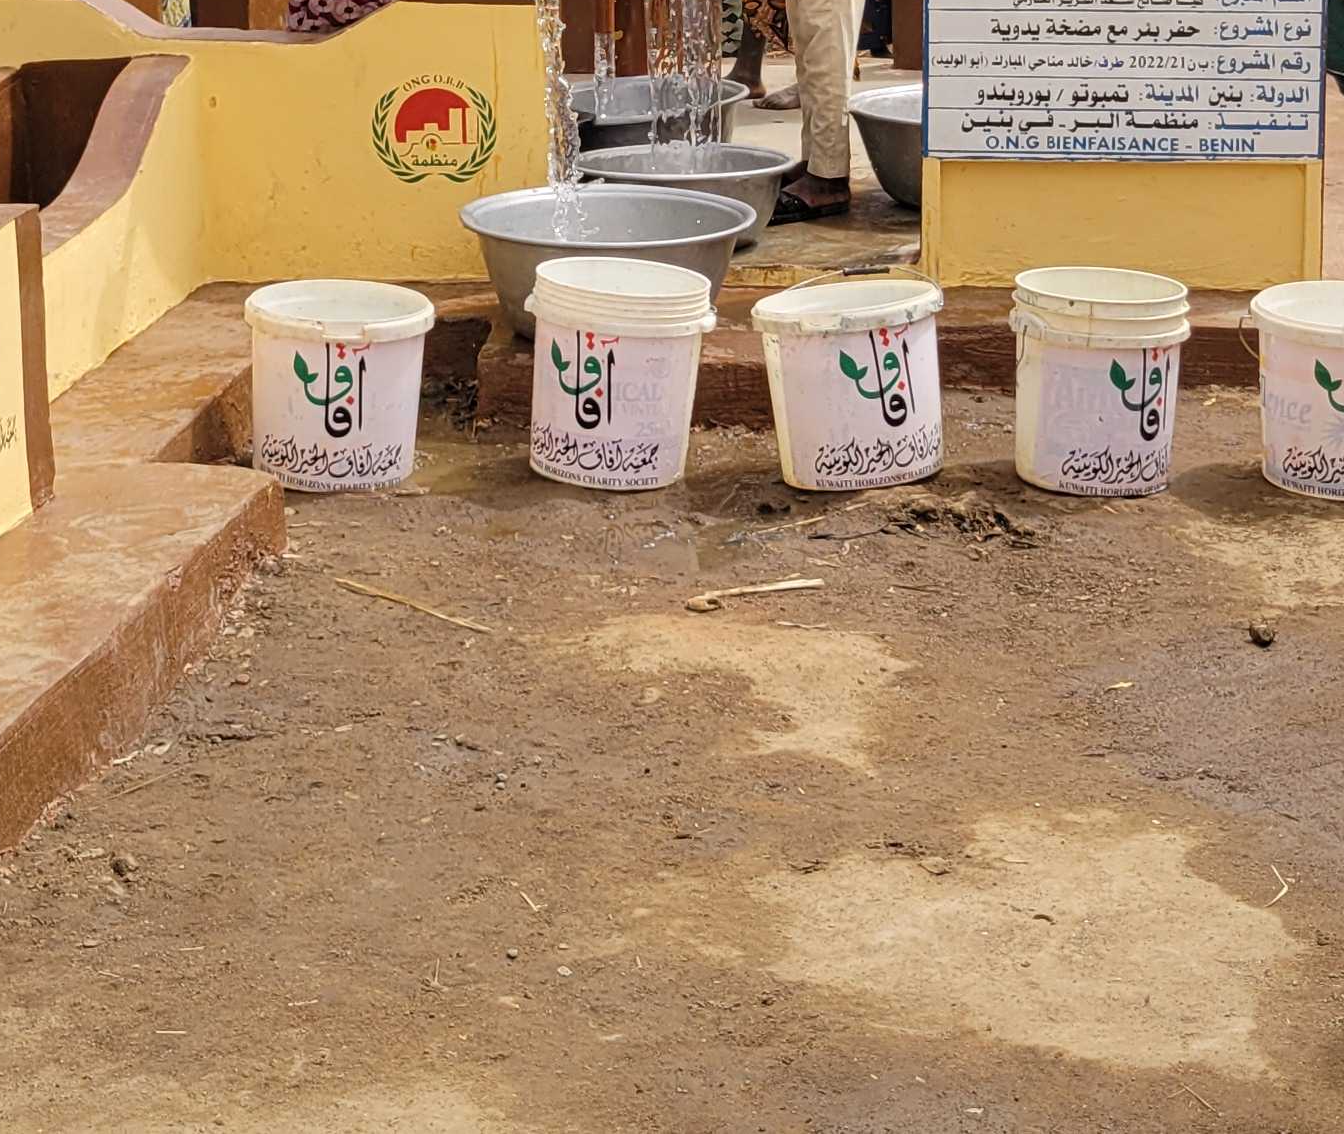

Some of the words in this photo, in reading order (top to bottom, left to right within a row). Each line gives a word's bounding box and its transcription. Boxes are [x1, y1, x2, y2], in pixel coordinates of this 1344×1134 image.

[990, 18, 1041, 41] يدوية
[1045, 18, 1102, 39] مضخة
[1106, 23, 1128, 44] مع
[1165, 19, 1201, 42] حفر
[1213, 15, 1279, 41] المشروع:
[1282, 18, 1312, 42] نوع
[991, 53, 1026, 70] المبارك
[1280, 51, 1312, 75] رقم
[402, 74, 431, 92] ONG
[1056, 88, 1065, 103] /
[1138, 83, 1200, 107] المدينة:
[1208, 84, 1244, 108] بنين
[1250, 83, 1311, 108] الدولة:
[961, 109, 1014, 133] بنين
[1018, 110, 1055, 135] في
[1069, 111, 1121, 133] البر
[1124, 110, 1199, 131] منظمة
[985, 135, 1041, 151] O.N.G
[1046, 136, 1180, 153] BIENFAISANCE
[1198, 138, 1256, 154] BENIN
[410, 153, 459, 168] منظمة
